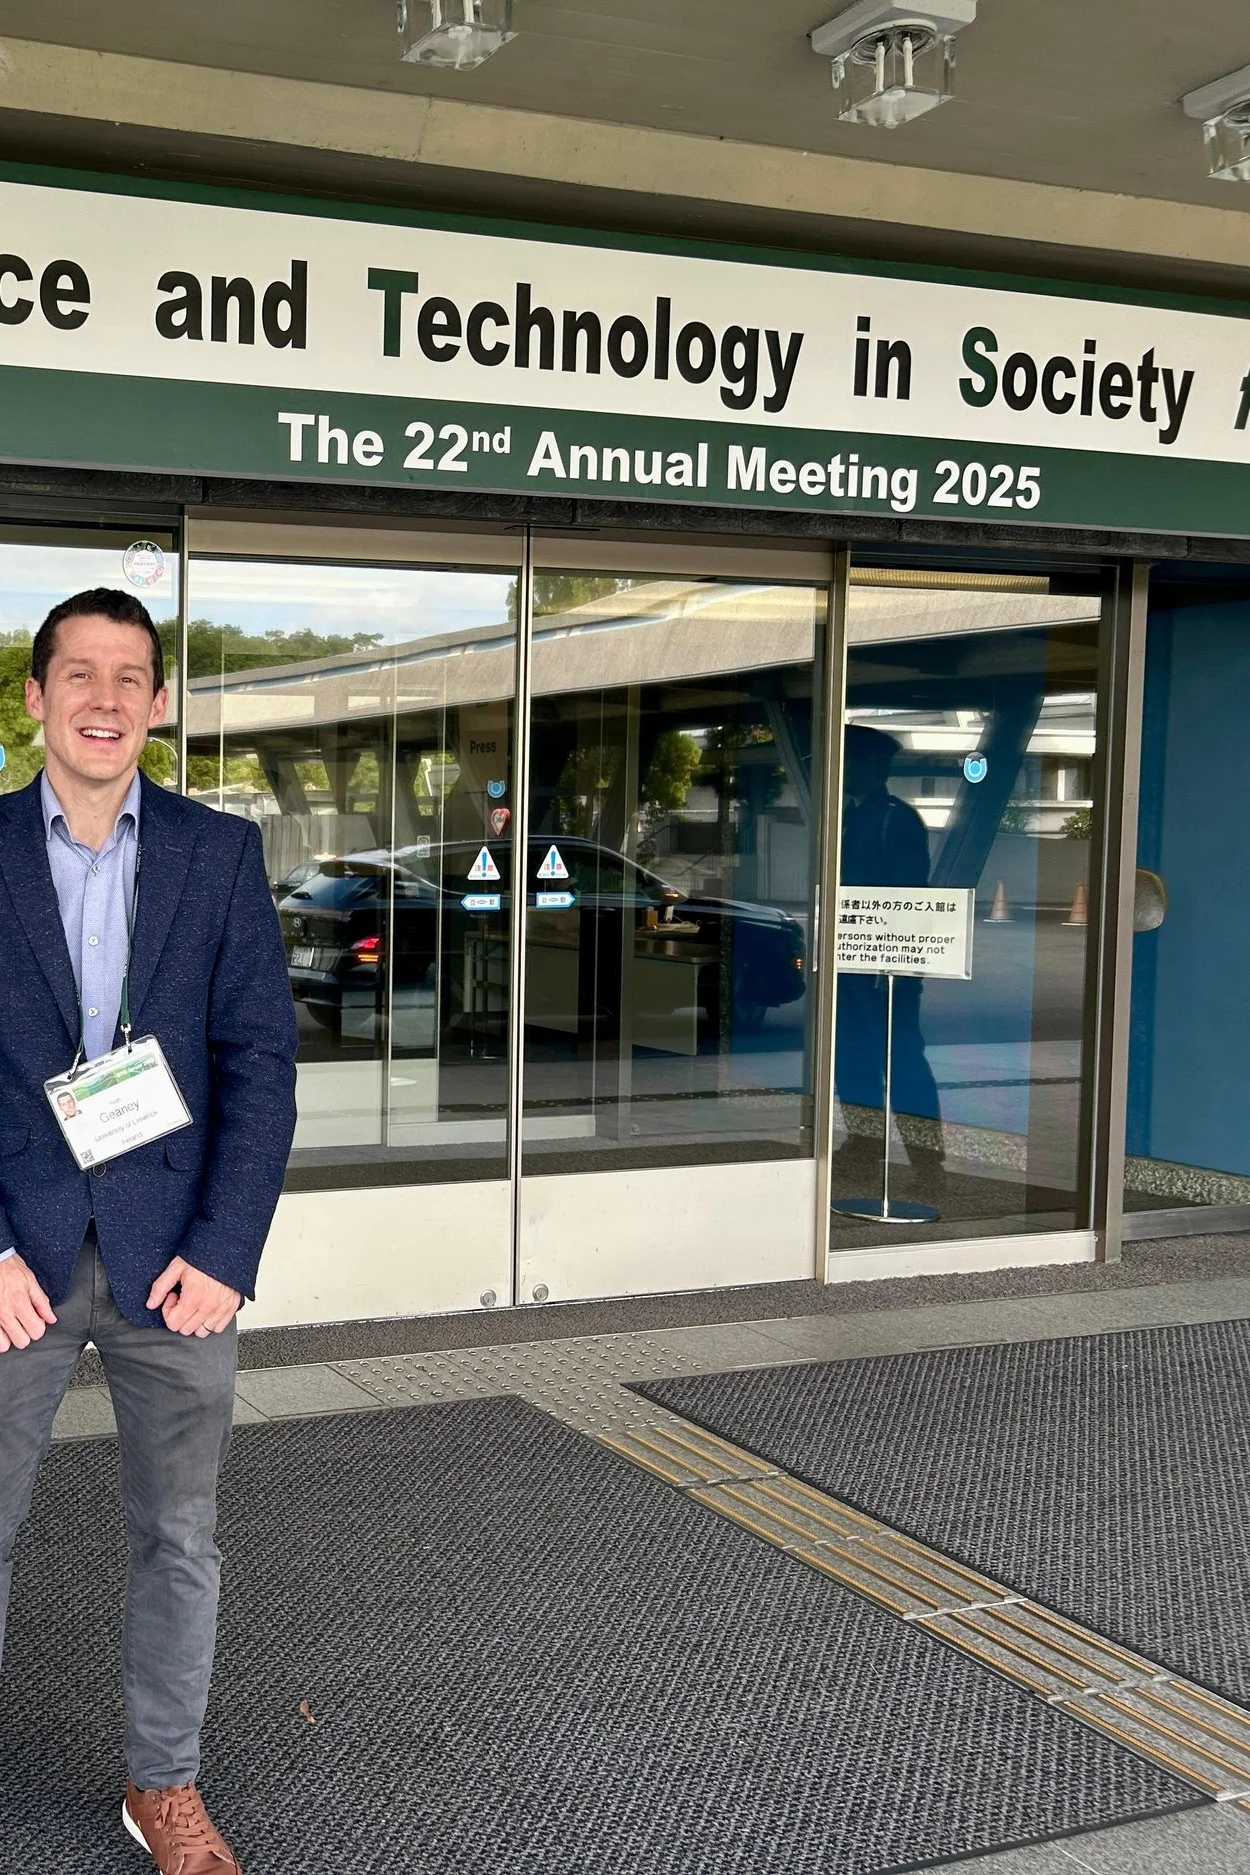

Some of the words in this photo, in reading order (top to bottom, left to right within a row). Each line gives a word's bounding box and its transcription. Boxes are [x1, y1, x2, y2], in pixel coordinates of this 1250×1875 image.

[155, 260, 308, 350] and
[368, 267, 804, 413] Technology
[852, 316, 911, 401] in
[958, 325, 1195, 445] Society
[277, 412, 385, 467] The
[403, 421, 512, 472] 22nd
[527, 431, 708, 488] Annual
[726, 444, 918, 513] Meeting
[932, 460, 1041, 510] 2025
[470, 740, 497, 754] Press
[875, 932, 916, 943] without
[918, 935, 955, 946] proper
[901, 945, 923, 954] may
[926, 946, 945, 955] not
[860, 953, 877, 962] the
[880, 954, 930, 964] facilities.
[99, 1099, 141, 1123] Geaney
